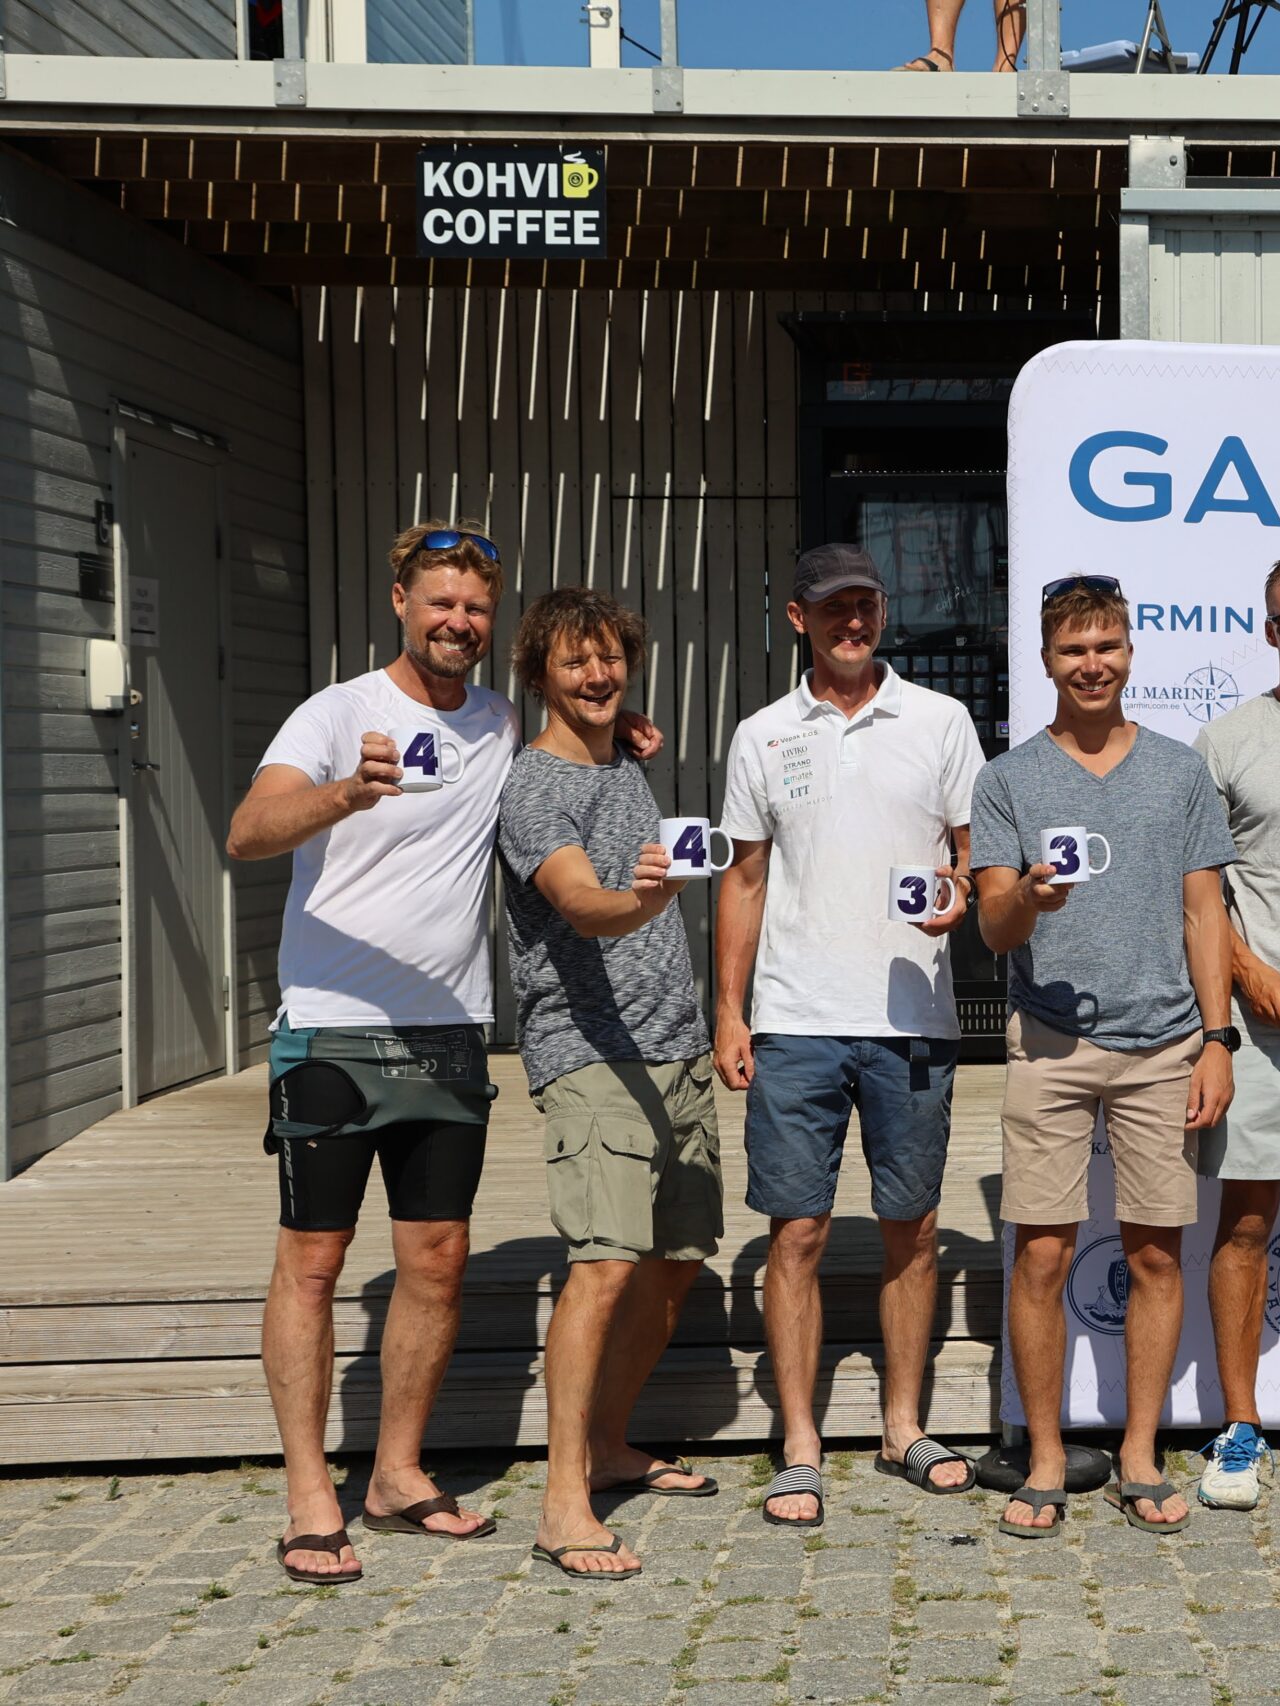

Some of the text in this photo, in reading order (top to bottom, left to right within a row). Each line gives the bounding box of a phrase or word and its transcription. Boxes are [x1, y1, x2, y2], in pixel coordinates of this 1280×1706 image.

[423, 161, 558, 198] KOHVI
[422, 207, 600, 245] COFFEE
[1129, 603, 1254, 634] RMIN
[1143, 686, 1216, 701] MARINE
[402, 732, 439, 776] 4
[783, 758, 812, 770] STRAND
[672, 825, 707, 868] 4
[1049, 834, 1081, 876] 3
[897, 875, 928, 915] 3
